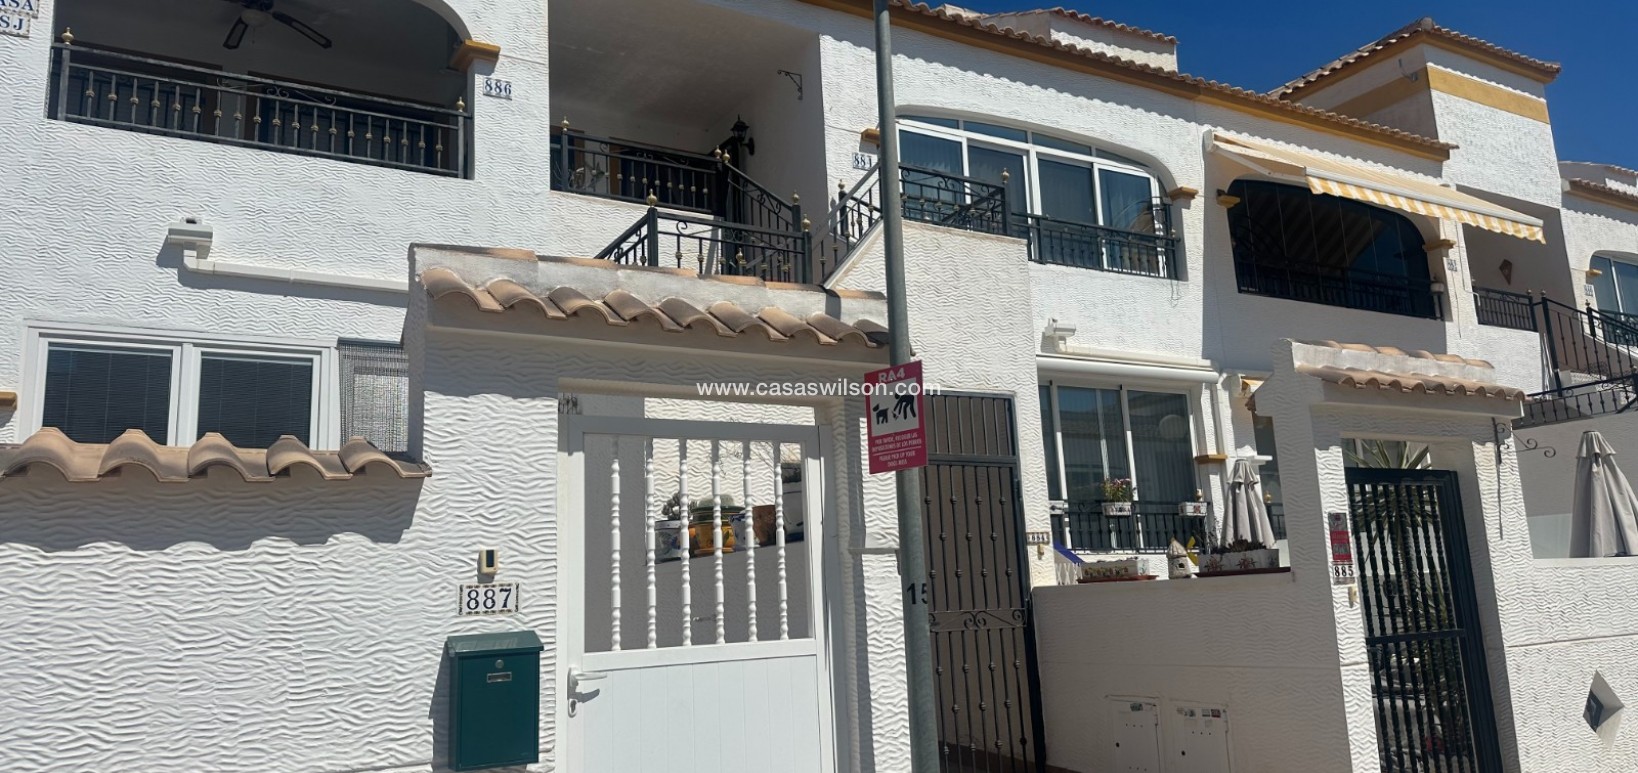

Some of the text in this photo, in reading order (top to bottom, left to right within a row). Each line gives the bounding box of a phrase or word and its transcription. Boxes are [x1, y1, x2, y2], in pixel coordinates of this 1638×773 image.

[0, 0, 33, 11] SA
[485, 79, 512, 95] 886
[878, 367, 906, 383] RA4
[1334, 565, 1354, 577] 885
[466, 588, 512, 610] 887
